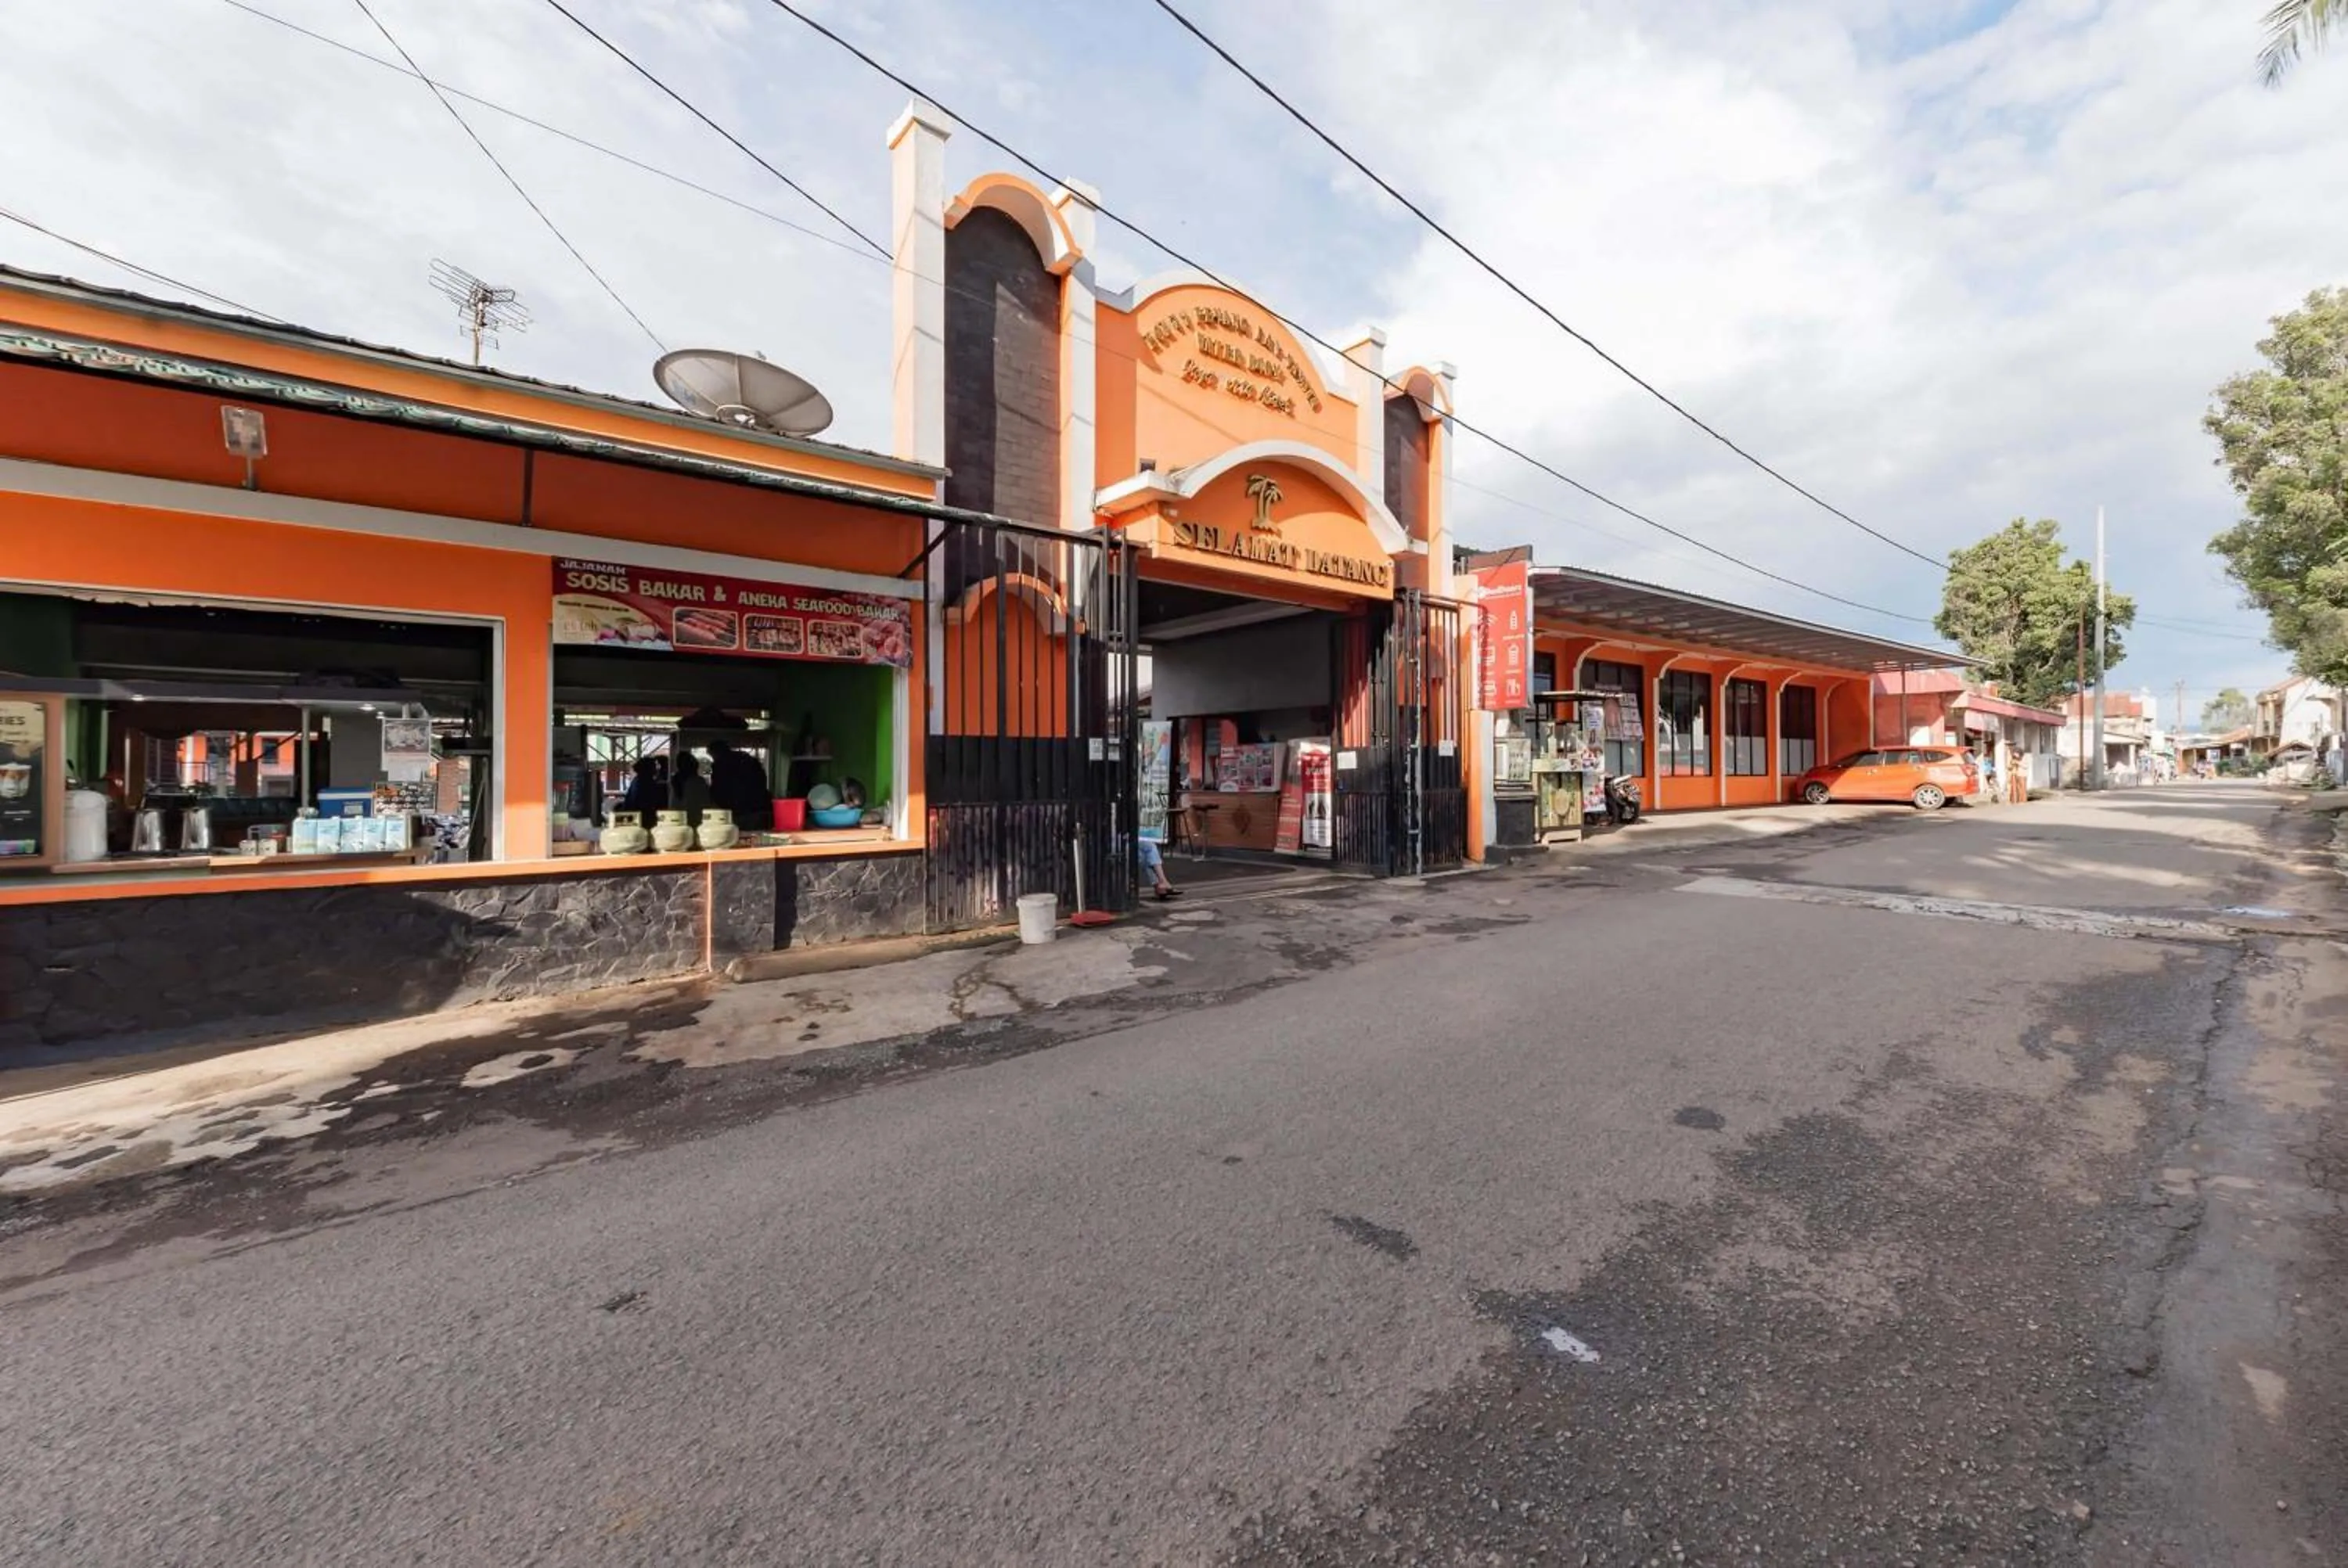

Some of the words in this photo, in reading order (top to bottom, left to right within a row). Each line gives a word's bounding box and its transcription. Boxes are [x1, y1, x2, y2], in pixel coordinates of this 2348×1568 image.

[1174, 522, 1300, 570] SELAMAT
[1304, 548, 1388, 588] DATANG
[566, 572, 629, 594] SOSIS
[639, 579, 705, 602] BAKAR
[713, 584, 727, 602] &
[738, 591, 788, 609] ANEKA
[792, 597, 853, 616] SEAFOOD
[855, 604, 900, 621] BAKAR
